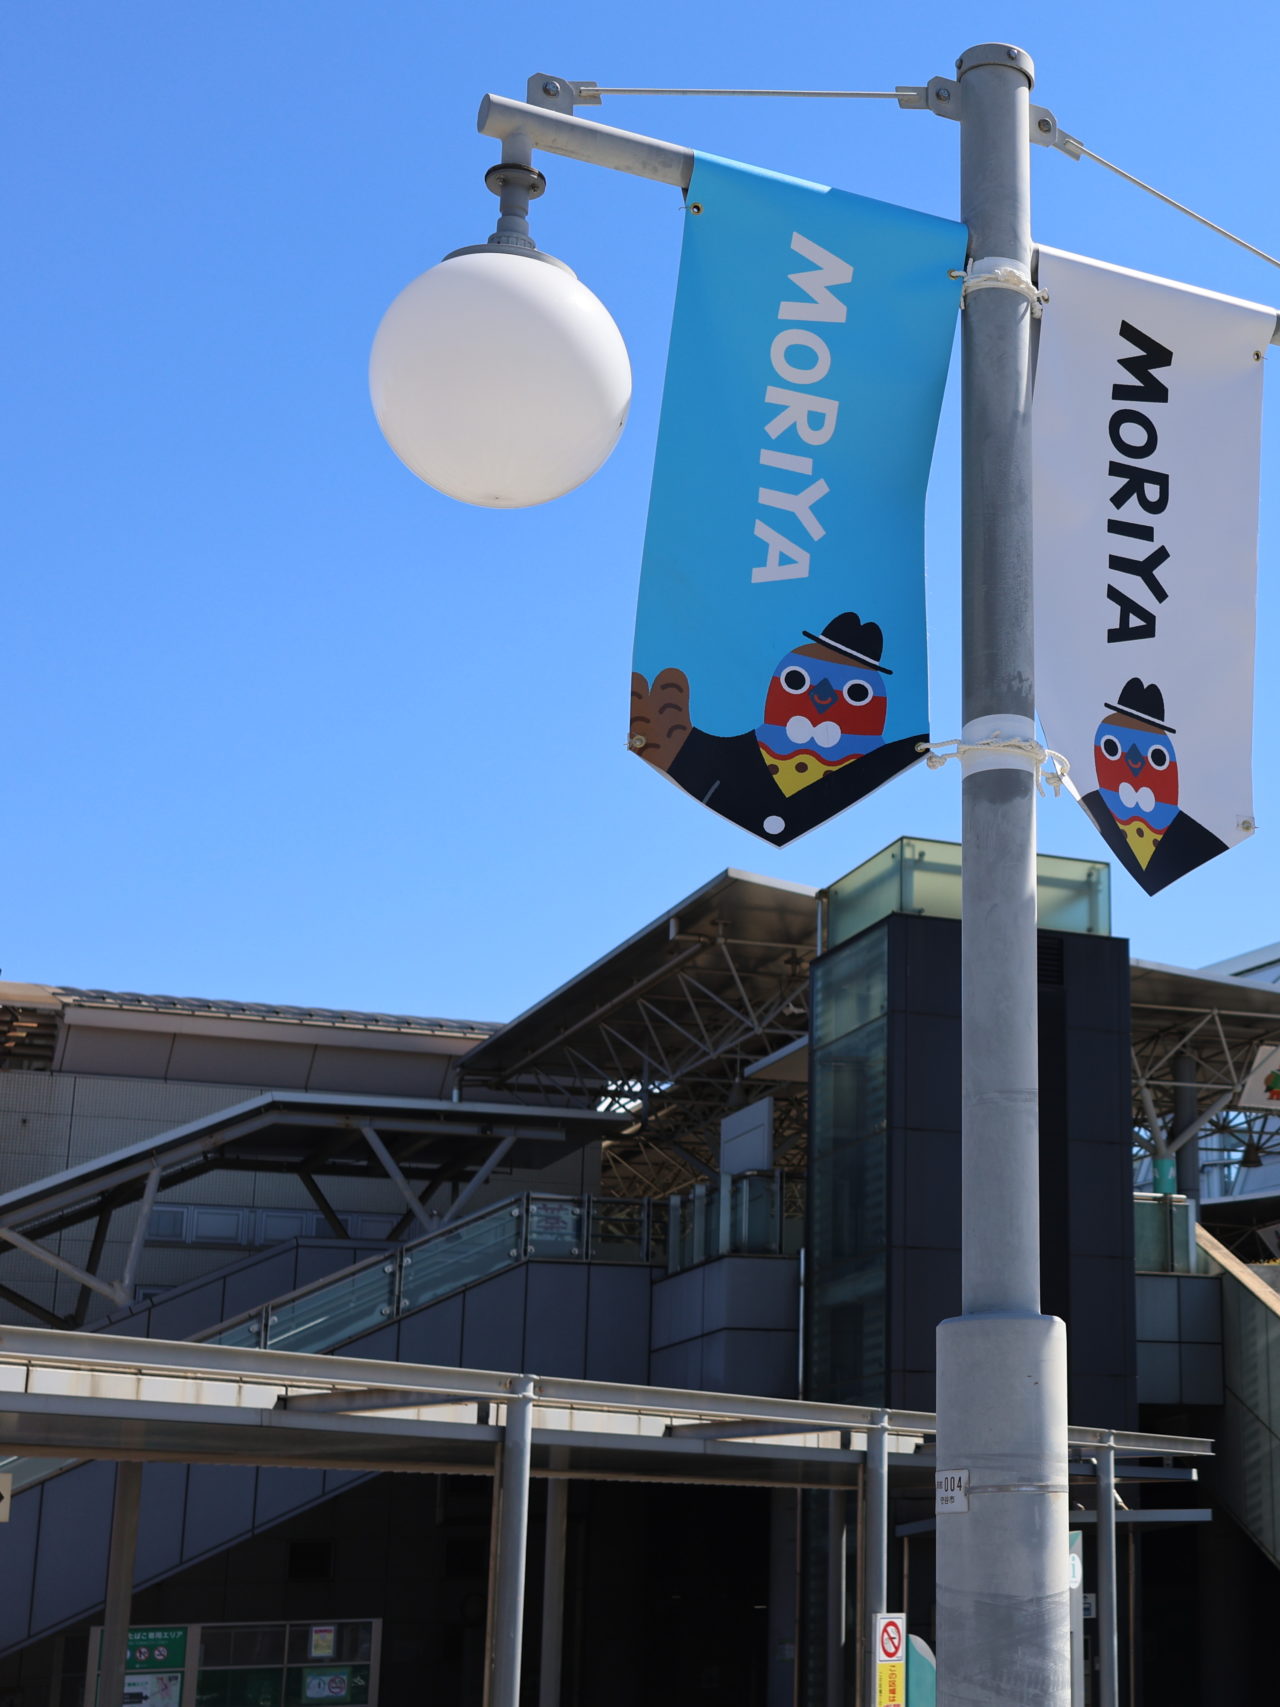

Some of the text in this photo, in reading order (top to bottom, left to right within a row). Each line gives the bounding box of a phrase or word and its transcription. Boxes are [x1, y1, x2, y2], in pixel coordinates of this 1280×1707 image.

[751, 231, 855, 584] MORIYA
[1106, 319, 1174, 644] MORIYA
[944, 1476, 962, 1492] 004
